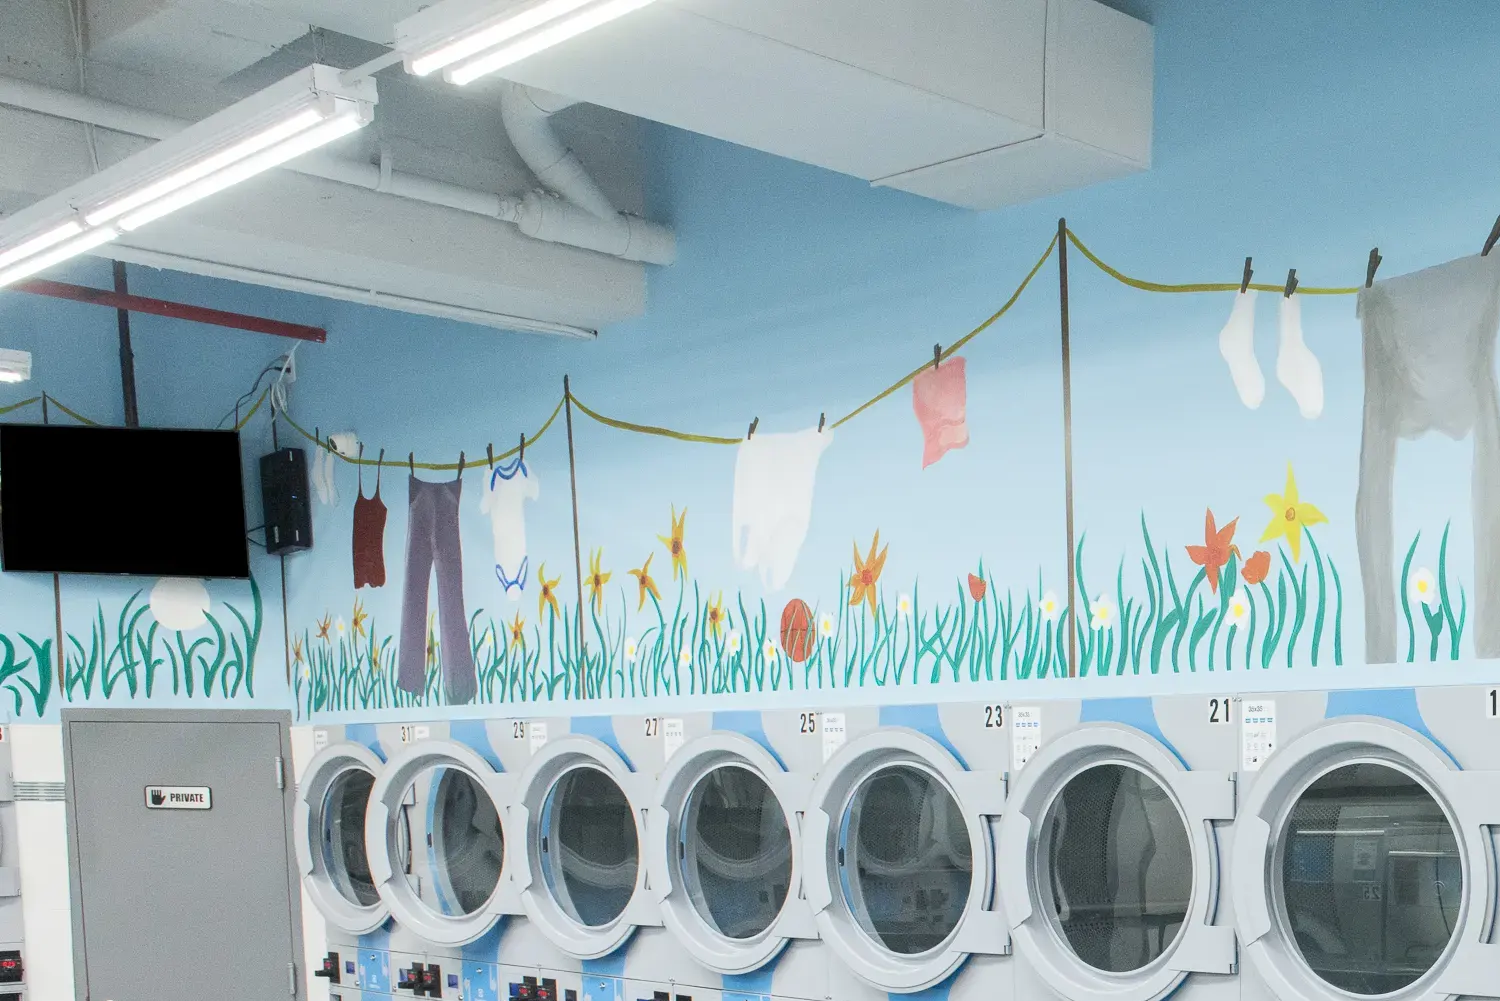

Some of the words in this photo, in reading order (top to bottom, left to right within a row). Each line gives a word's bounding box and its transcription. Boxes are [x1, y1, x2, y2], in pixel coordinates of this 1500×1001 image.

[985, 705, 1003, 728] 23
[1209, 699, 1229, 723] 21
[513, 721, 525, 739] 29
[645, 717, 658, 737] 27
[800, 712, 815, 733] 25
[401, 725, 411, 742] 31
[170, 793, 204, 803] PRIVATE
